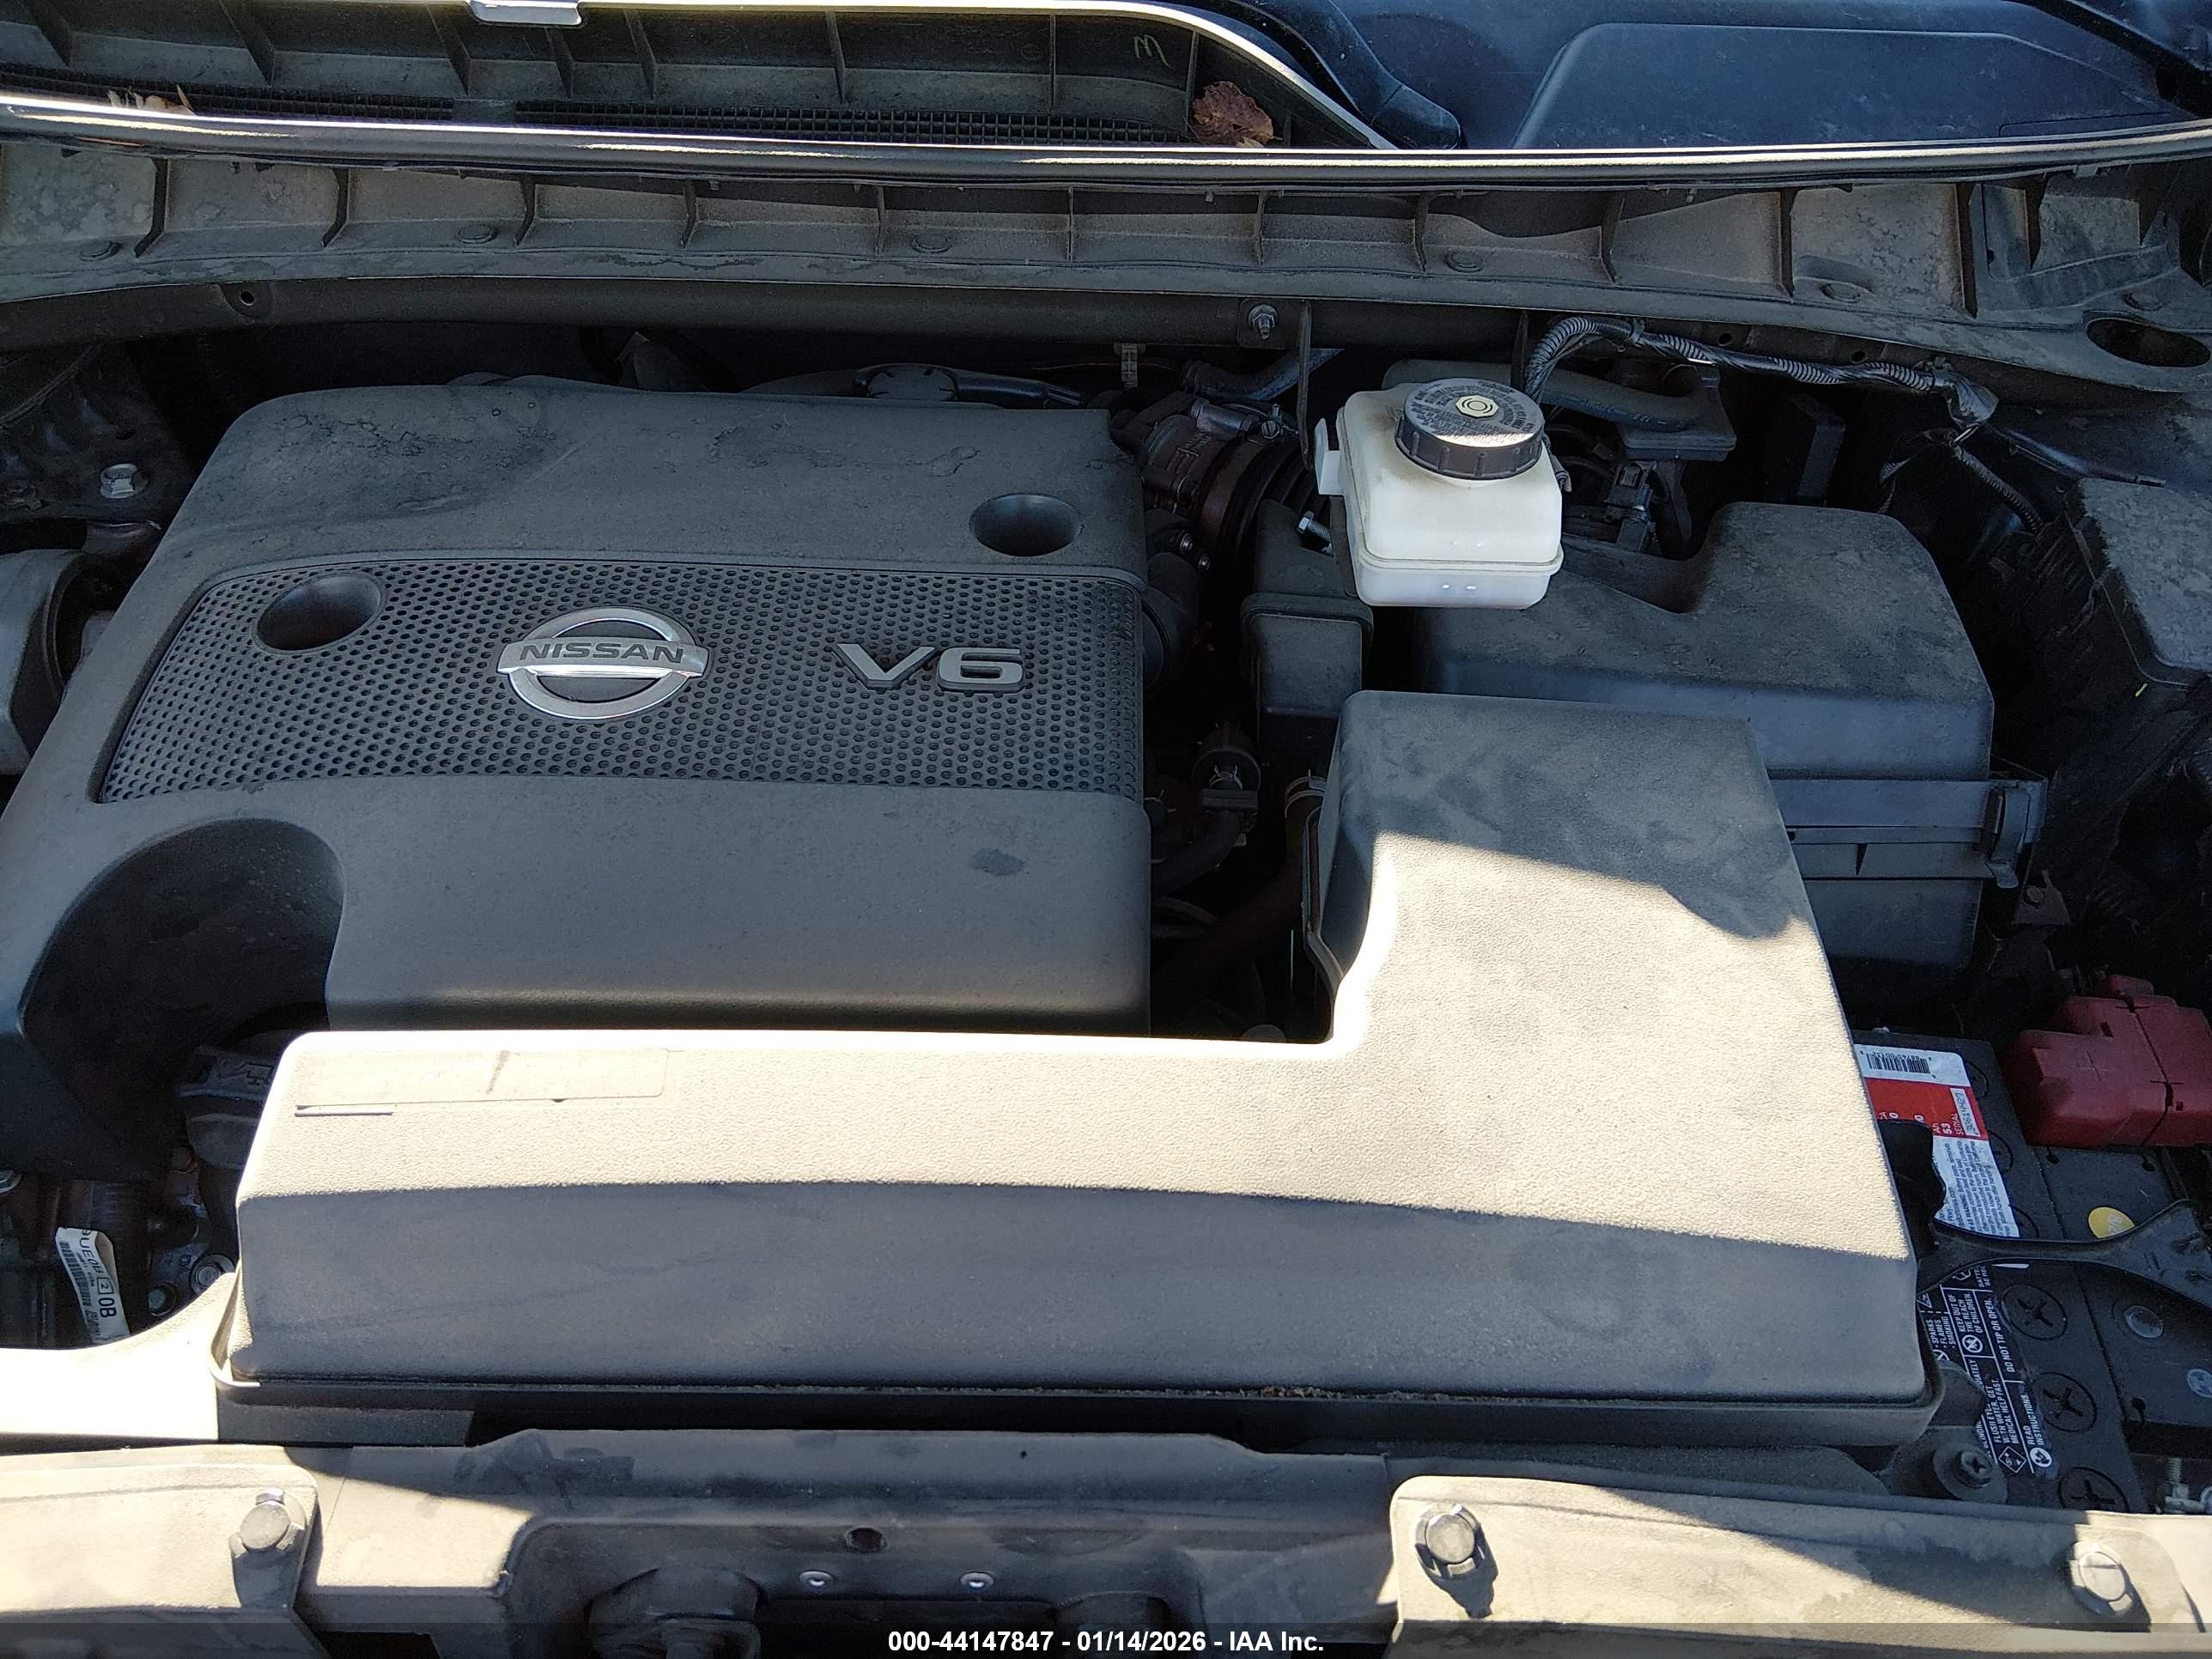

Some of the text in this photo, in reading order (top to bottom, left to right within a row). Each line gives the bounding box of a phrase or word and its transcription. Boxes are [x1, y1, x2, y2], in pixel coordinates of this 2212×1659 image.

[520, 641, 684, 665] NISSAN
[832, 642, 1024, 693] V6
[1951, 1112, 1964, 1135] SERIAL
[1974, 1266, 1984, 1288] BATTE
[1948, 1294, 1966, 1333] KEEP OUT OF
[1958, 1299, 1975, 1332] THE REACH
[1964, 1292, 1984, 1334] OF CHILDREN.
[1926, 1319, 1939, 1344] SPARKS
[1934, 1319, 1948, 1344] FLAMES
[1941, 1316, 1956, 1345] SMOKING
[1984, 1298, 2015, 1372] DO NOT TIP OR OPEN.
[1985, 1385, 1996, 1398] GET
[1990, 1400, 2002, 1424] WATER.
[1991, 1378, 2020, 1444] MEDICAL HELP FAST.
[2021, 1393, 2045, 1446] INSTRUCTIONS.
[1989, 1420, 2002, 1443] FLUSH
[2023, 1425, 2035, 1445] READ
